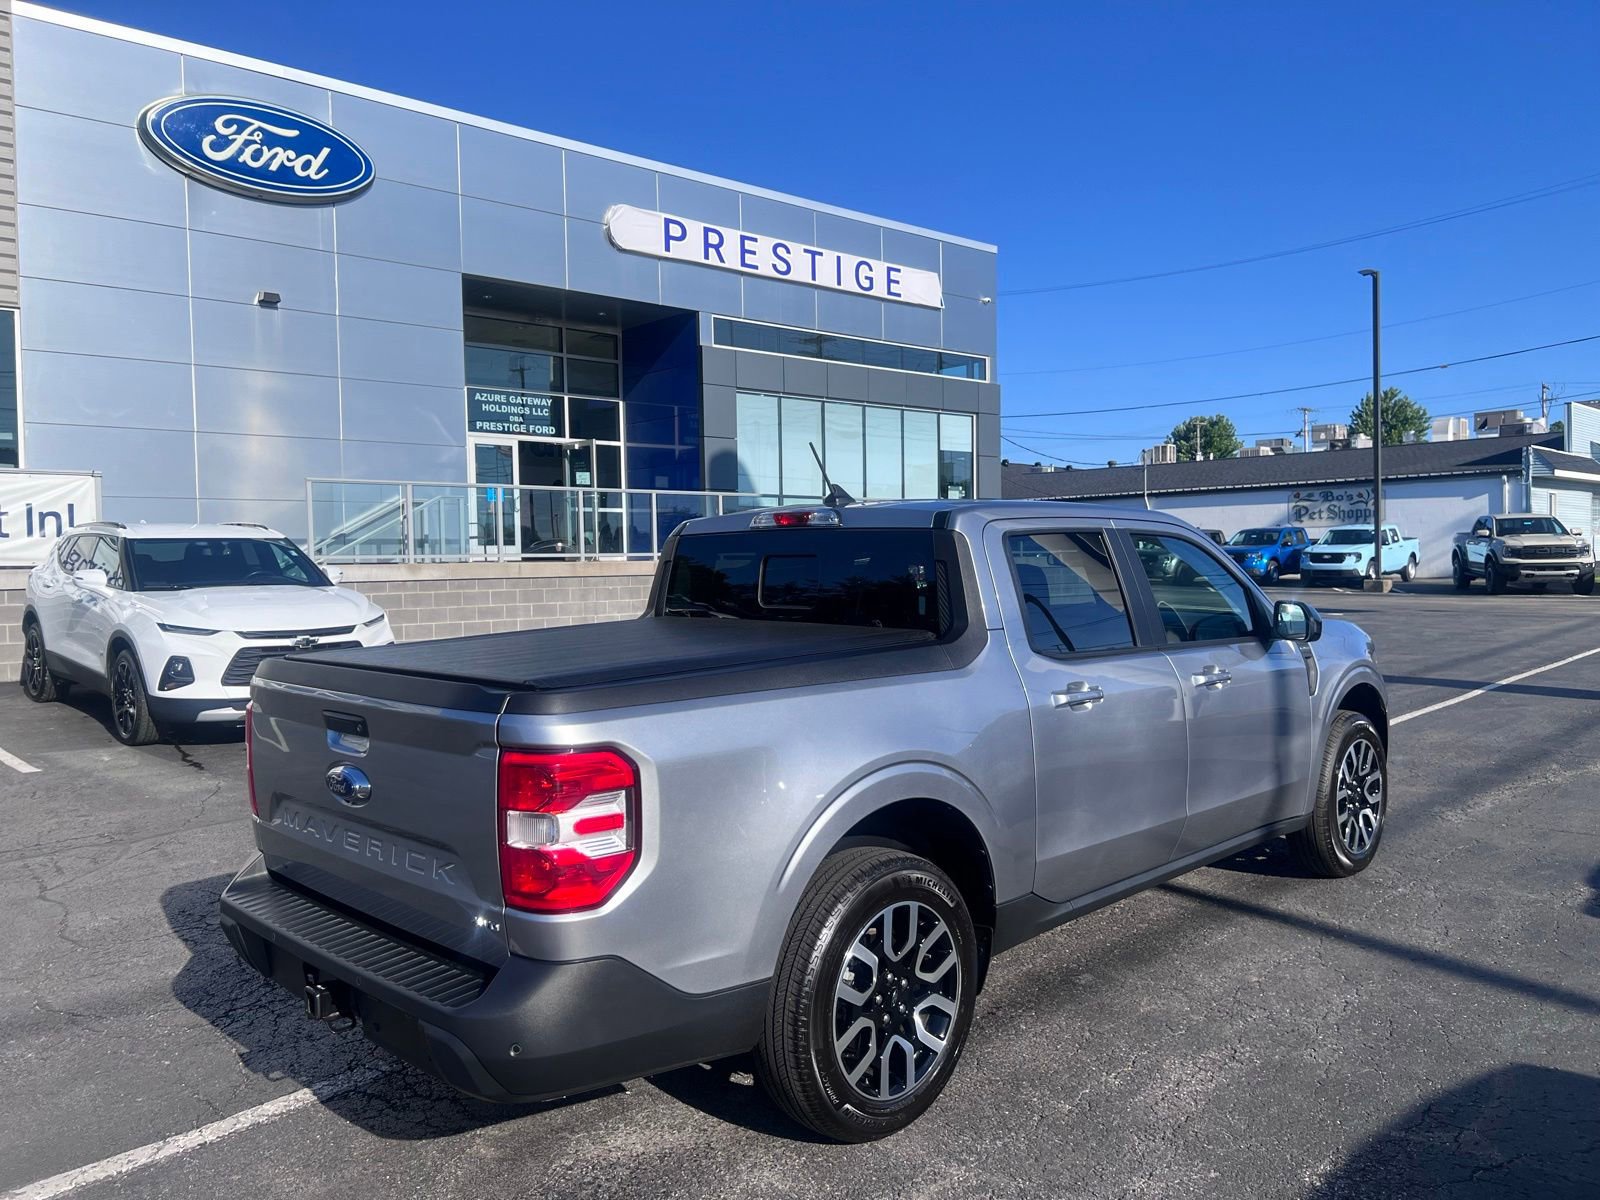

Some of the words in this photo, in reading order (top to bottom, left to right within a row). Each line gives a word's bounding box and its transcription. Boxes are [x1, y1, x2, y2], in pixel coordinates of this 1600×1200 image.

[201, 113, 332, 181] Ford
[662, 216, 904, 299] PRESTIGE
[474, 392, 507, 402] AZURE
[509, 395, 553, 407] GATEWAY
[481, 403, 530, 415] HOLDINGS
[532, 407, 550, 416] LLC
[475, 421, 527, 433] PRESTIGE
[529, 424, 556, 435] FORD
[509, 415, 524, 423] DBA
[1319, 490, 1354, 502] Bo's
[1291, 503, 1325, 523] Pet
[1326, 503, 1377, 524] Shopp
[283, 806, 457, 886] MAVERICK
[915, 875, 957, 904] MICHELIN
